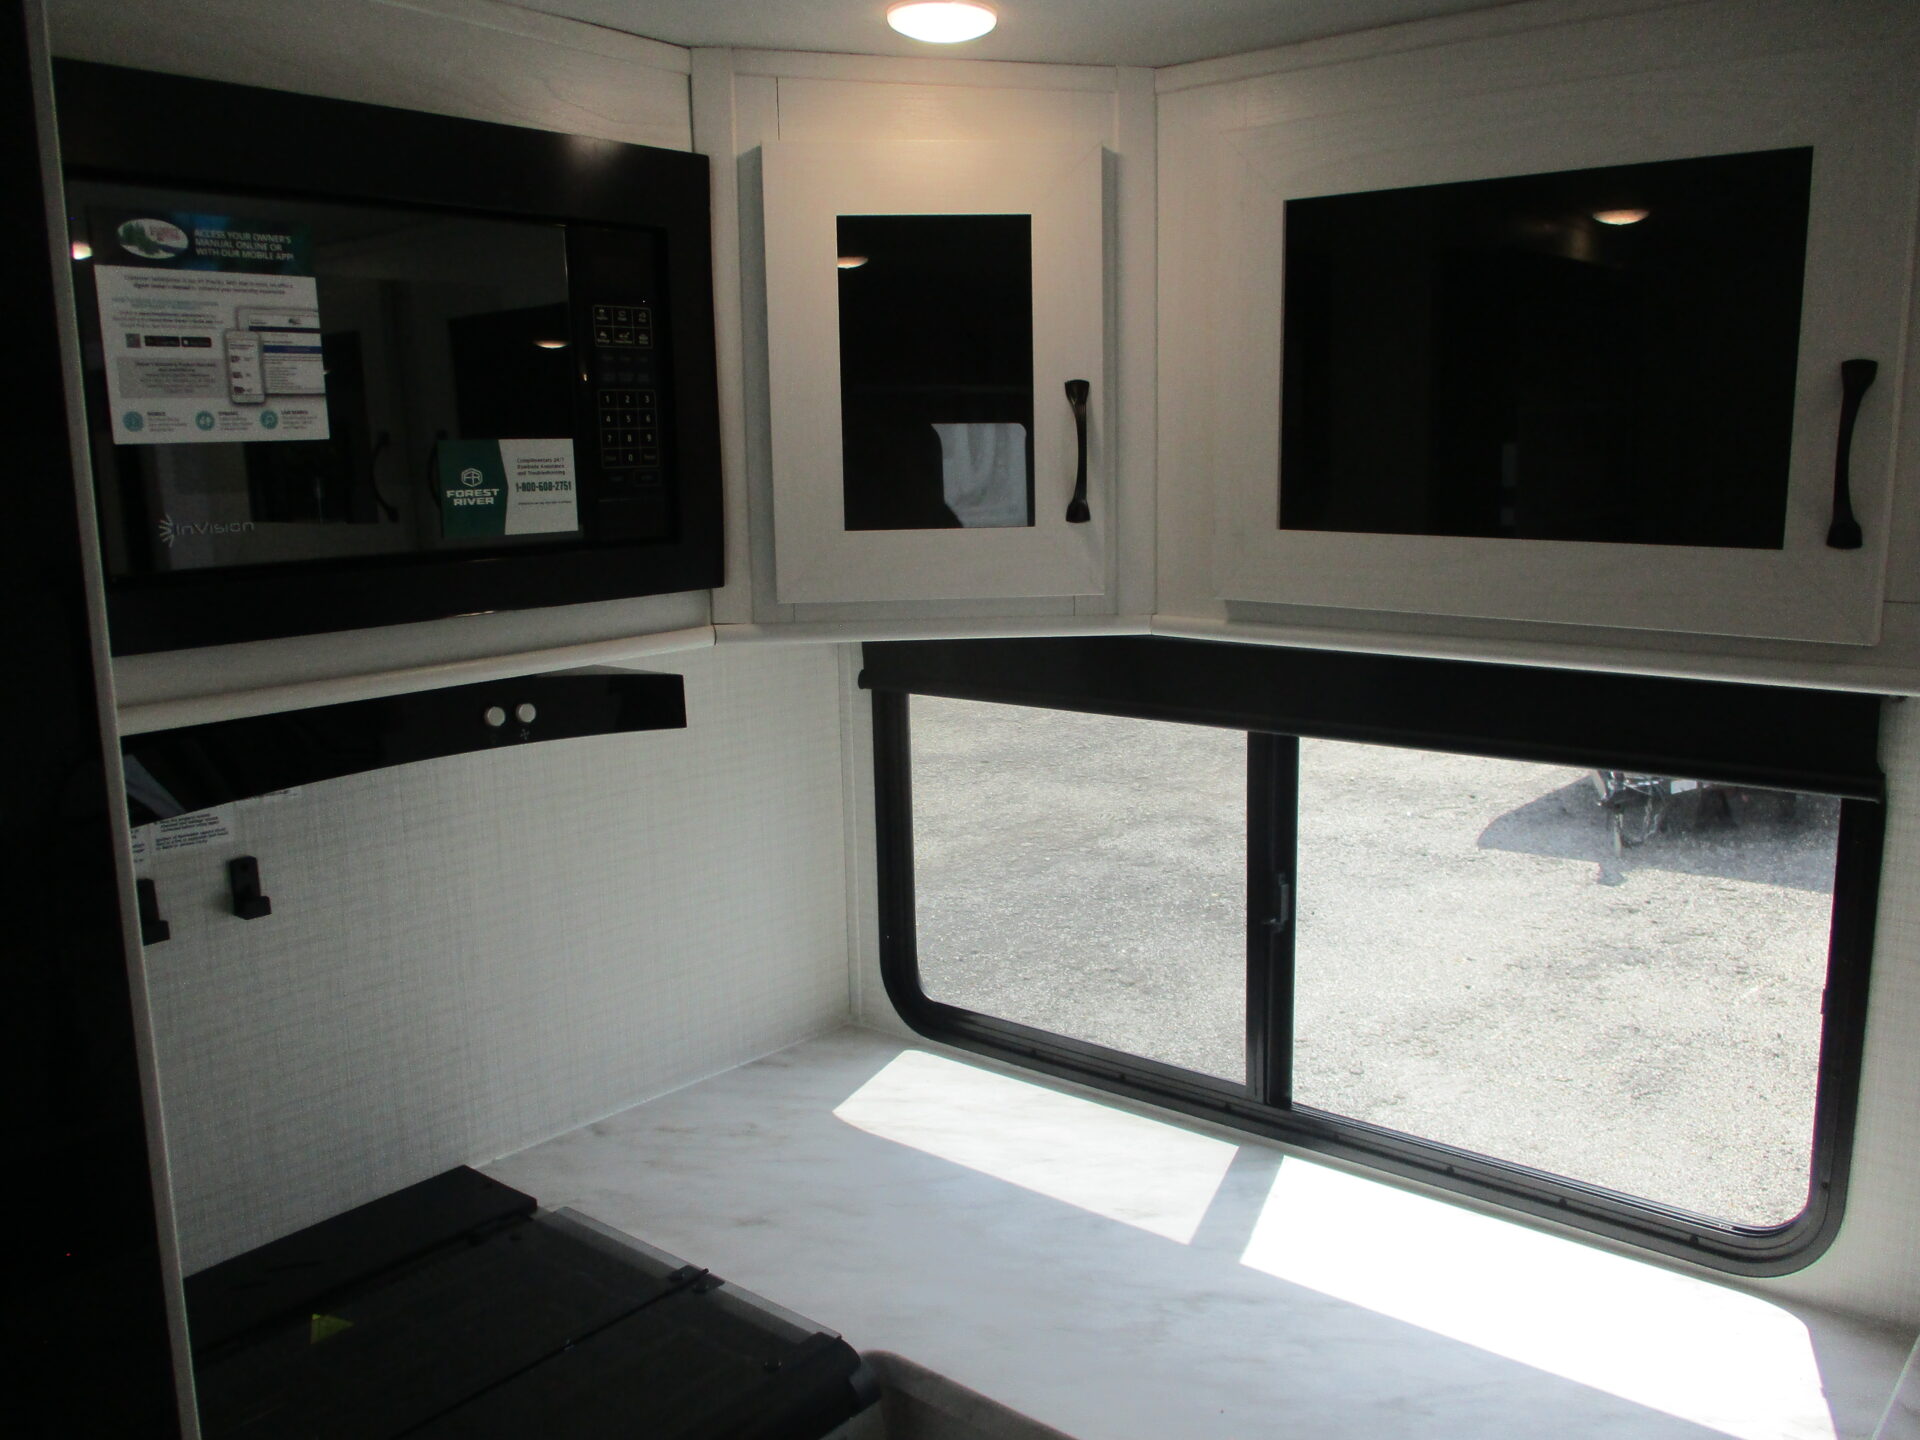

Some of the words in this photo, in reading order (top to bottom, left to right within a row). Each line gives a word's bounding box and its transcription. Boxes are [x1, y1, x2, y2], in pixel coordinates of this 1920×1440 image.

[194, 229, 226, 239] ACCESS
[227, 231, 251, 241] YOUR
[253, 232, 292, 244] OWNER'S
[195, 238, 233, 248] MANUAL
[236, 240, 267, 251] ONLINE
[269, 243, 283, 251] OR
[196, 247, 219, 256] WITH
[221, 249, 240, 258] OUR
[242, 250, 274, 260] MOBILE
[515, 481, 572, 492] 1-800-608-2751
[446, 488, 499, 498] FOREST
[453, 496, 495, 506] RIVER
